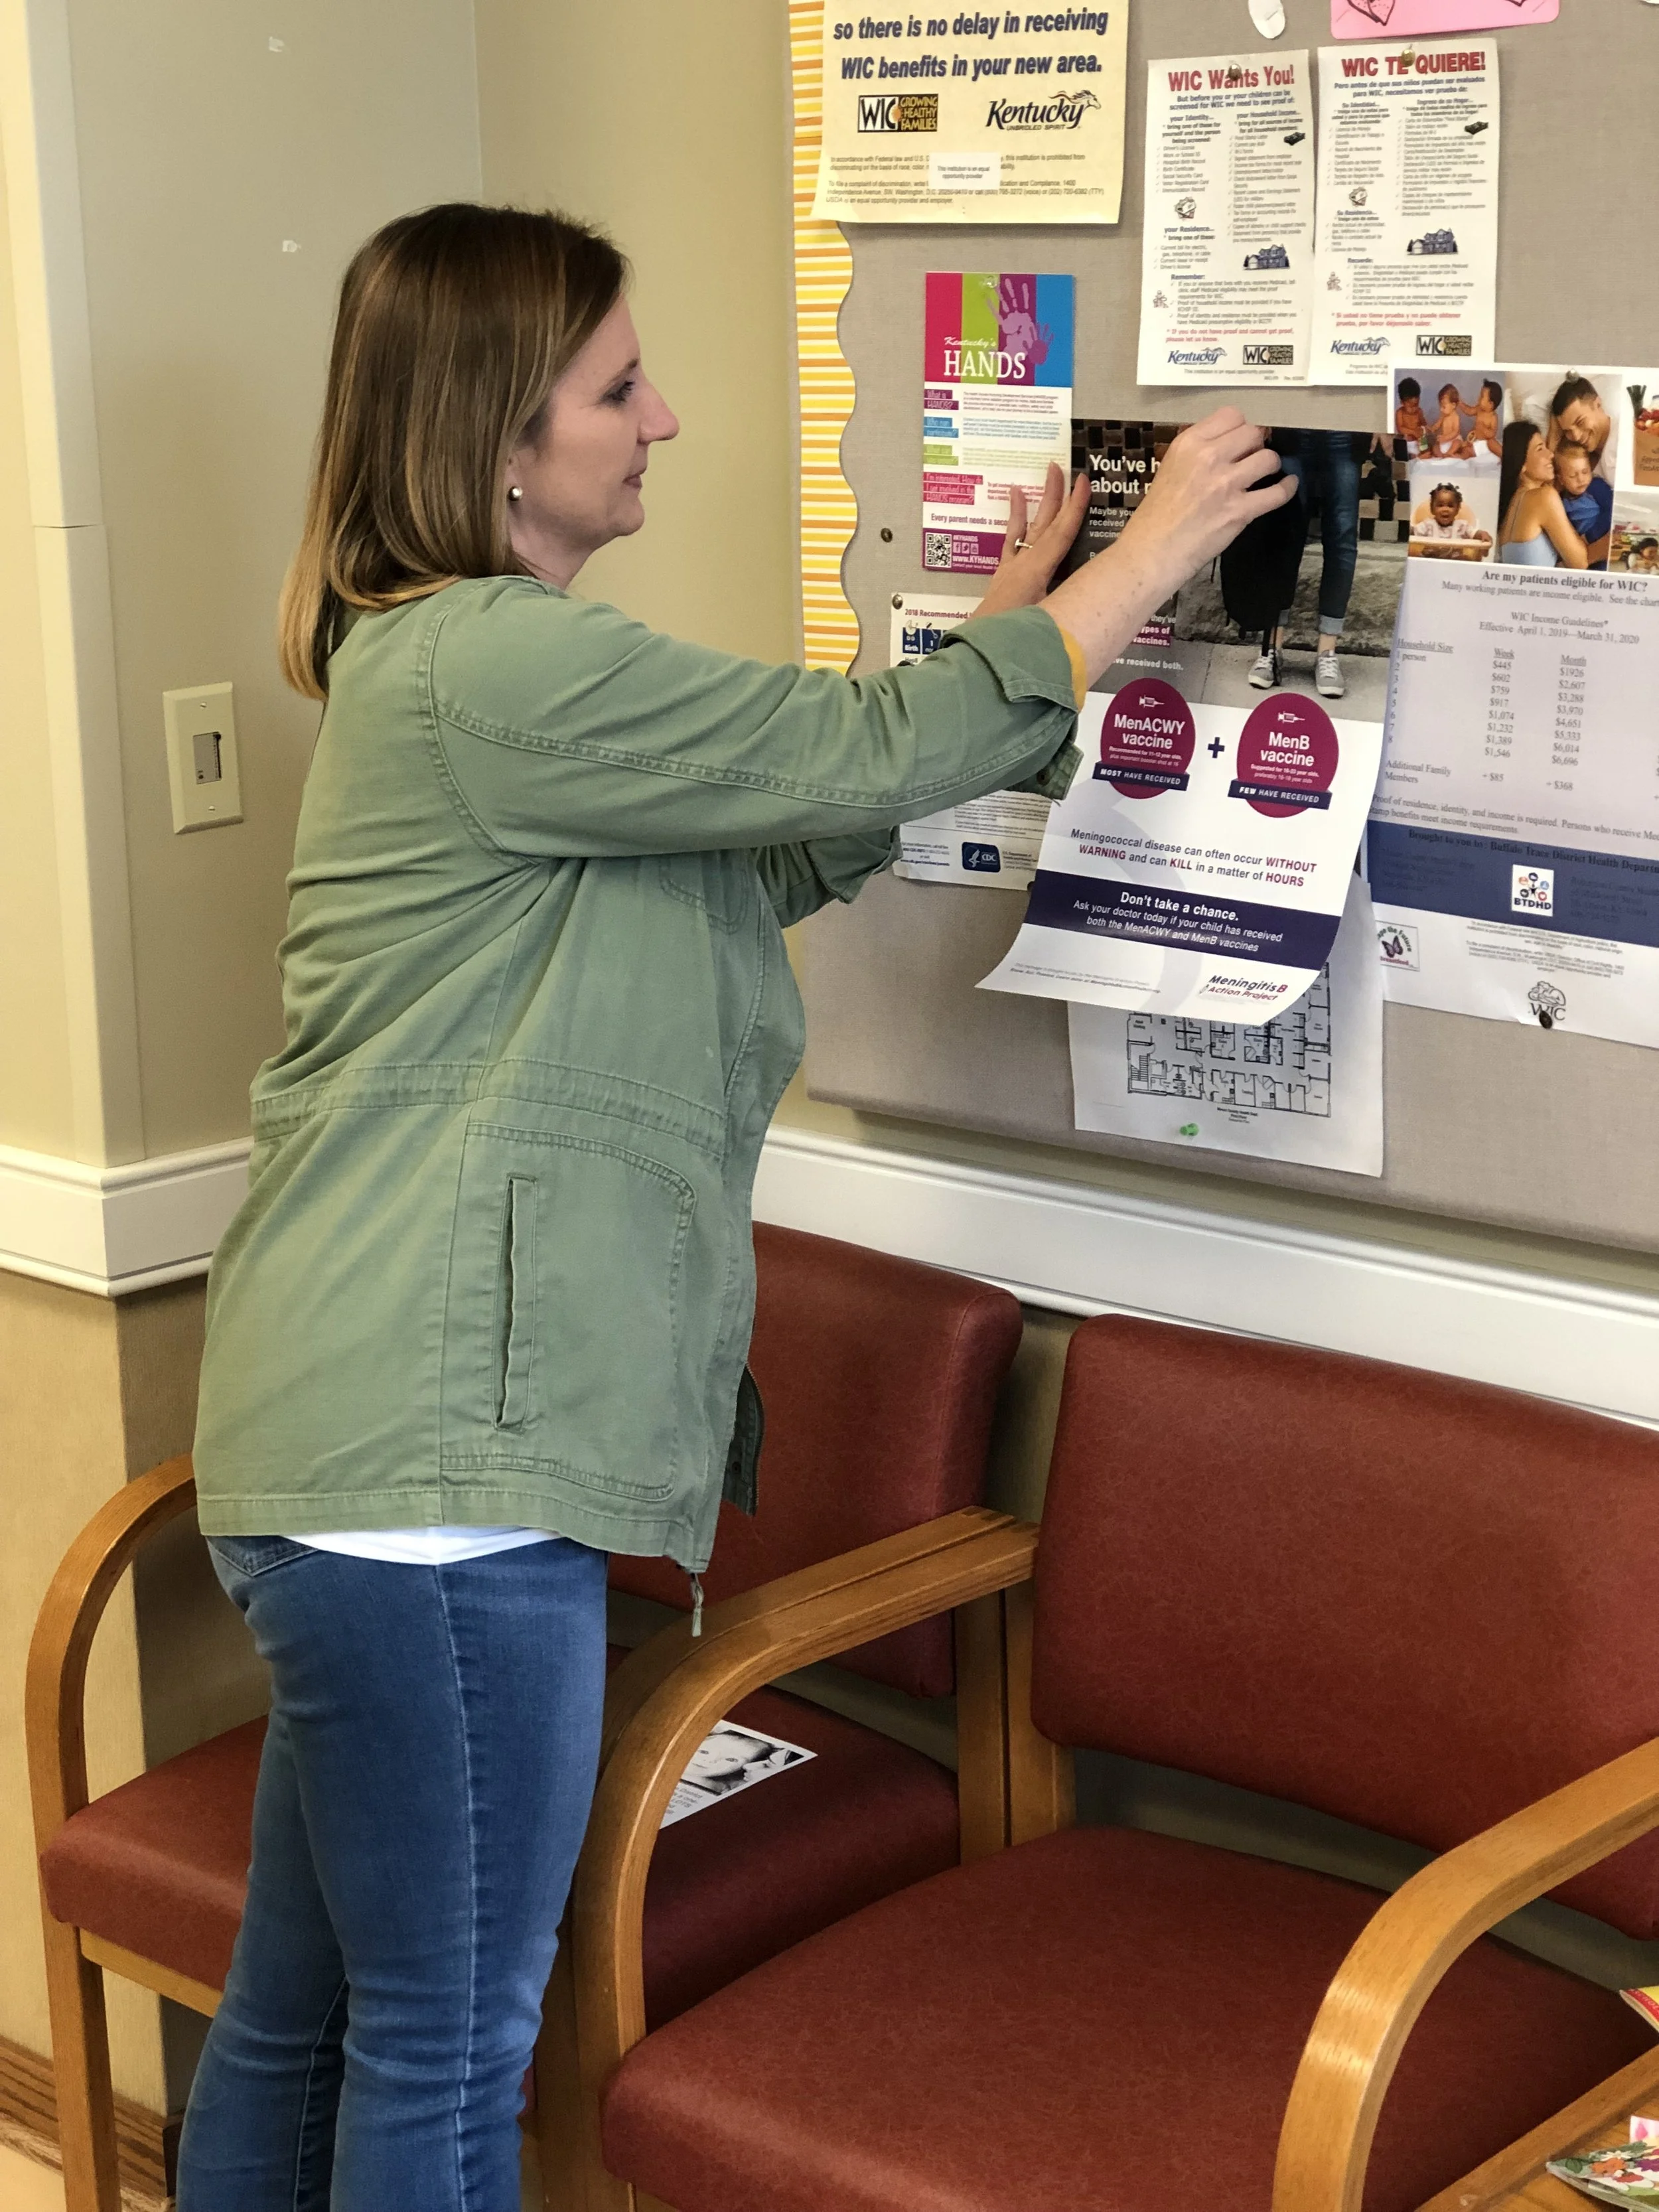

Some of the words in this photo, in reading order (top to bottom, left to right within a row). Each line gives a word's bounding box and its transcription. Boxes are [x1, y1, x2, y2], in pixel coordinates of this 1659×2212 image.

[833, 23, 853, 39] so
[859, 17, 902, 38] there
[907, 15, 921, 37] is
[926, 19, 947, 36] no
[952, 12, 999, 39] delay
[1003, 10, 1019, 33] in
[1025, 8, 1109, 35] receiving
[841, 56, 875, 79] WIC
[879, 55, 946, 78] benefits
[952, 54, 968, 76] in
[972, 55, 1011, 81] your
[1015, 54, 1052, 74] new
[1057, 54, 1102, 73] area.
[1342, 57, 1378, 77] WIC
[1385, 56, 1409, 75] TE
[1415, 51, 1485, 75] QUIERE!
[1168, 71, 1202, 91] WIC
[1208, 68, 1258, 89] Wants
[1263, 64, 1294, 86] You!
[901, 97, 938, 108] GROWING
[861, 97, 901, 130] WIC
[903, 108, 936, 118] HEALTHY
[985, 98, 1086, 130] Kentucky
[901, 119, 937, 131] FAMILIES
[944, 336, 996, 348] Kentucky's
[944, 350, 1026, 379] HANDS
[1090, 455, 1146, 473] You've
[1091, 477, 1139, 494] about
[931, 513, 948, 522] Every
[1090, 507, 1117, 516] Maybe
[1482, 571, 1500, 580] Are
[1502, 573, 1517, 584] my
[1520, 573, 1558, 585] patients
[1561, 577, 1597, 589] eligible
[1599, 579, 1615, 589] for
[1617, 580, 1648, 592] WIC?
[1442, 581, 1463, 592] Many
[1466, 584, 1496, 595] working
[1497, 587, 1526, 596] patients
[1573, 593, 1604, 603] eligible.
[1609, 594, 1623, 603] See
[1625, 595, 1638, 605] the
[920, 610, 968, 619] Recommended
[1511, 611, 1530, 621] WIC
[1532, 613, 1559, 625] Income
[1479, 621, 1514, 632] Effective
[1518, 626, 1537, 636] April
[1619, 634, 1640, 644] 2020
[1438, 642, 1454, 652] Size
[1494, 648, 1514, 658] Week
[1561, 654, 1587, 665] Month
[1127, 659, 1160, 668] received
[1163, 661, 1183, 670] both.
[1559, 667, 1584, 678] $1926
[1492, 673, 1510, 682] $602
[1490, 685, 1510, 694] $759
[1490, 698, 1508, 707] $917
[1114, 713, 1185, 735] MenACWY
[1488, 710, 1514, 720] $1,074
[1555, 717, 1581, 728] $4,651
[1122, 733, 1173, 749] vaccine
[1269, 731, 1310, 750] MenB
[1261, 750, 1314, 767] vaccine
[1100, 769, 1121, 777] MOST
[1145, 774, 1181, 784] RECEIVED
[1554, 780, 1573, 790] $368
[1281, 792, 1319, 803] RECEIVED
[981, 853, 995, 861] CDC
[1071, 829, 1143, 847] Meningococcal
[1145, 840, 1181, 853] disease
[1185, 847, 1202, 856] can
[1205, 849, 1230, 860] often
[1234, 854, 1262, 865] occur
[1265, 857, 1317, 873] WITHOUT
[1079, 844, 1126, 859] WARNING
[1129, 853, 1147, 863] and
[1150, 857, 1167, 866] can
[1170, 858, 1192, 869] KILL
[1196, 862, 1205, 871] in
[1217, 867, 1250, 879] matter
[1253, 871, 1263, 881] of
[1265, 873, 1304, 887] HOURS
[1120, 892, 1151, 907] Don't
[1155, 897, 1179, 911] take
[1183, 904, 1190, 913] a
[1193, 904, 1239, 921] chance.
[1514, 898, 1551, 910] BTDHD
[1073, 900, 1090, 911] Ask
[1091, 905, 1111, 913] your
[1113, 907, 1141, 919] doctor
[1143, 912, 1168, 925] today
[1178, 919, 1198, 928] your
[1200, 922, 1223, 932] child
[1224, 924, 1241, 935] has
[1243, 929, 1283, 942] received
[1086, 916, 1106, 926] both
[1108, 920, 1123, 929] the
[1124, 922, 1172, 936] MenACWY
[1172, 931, 1189, 940] and
[1191, 933, 1218, 944] MenB
[1219, 939, 1260, 952] vaccines
[1208, 986, 1240, 996] Action
[1242, 991, 1278, 1000] Project
